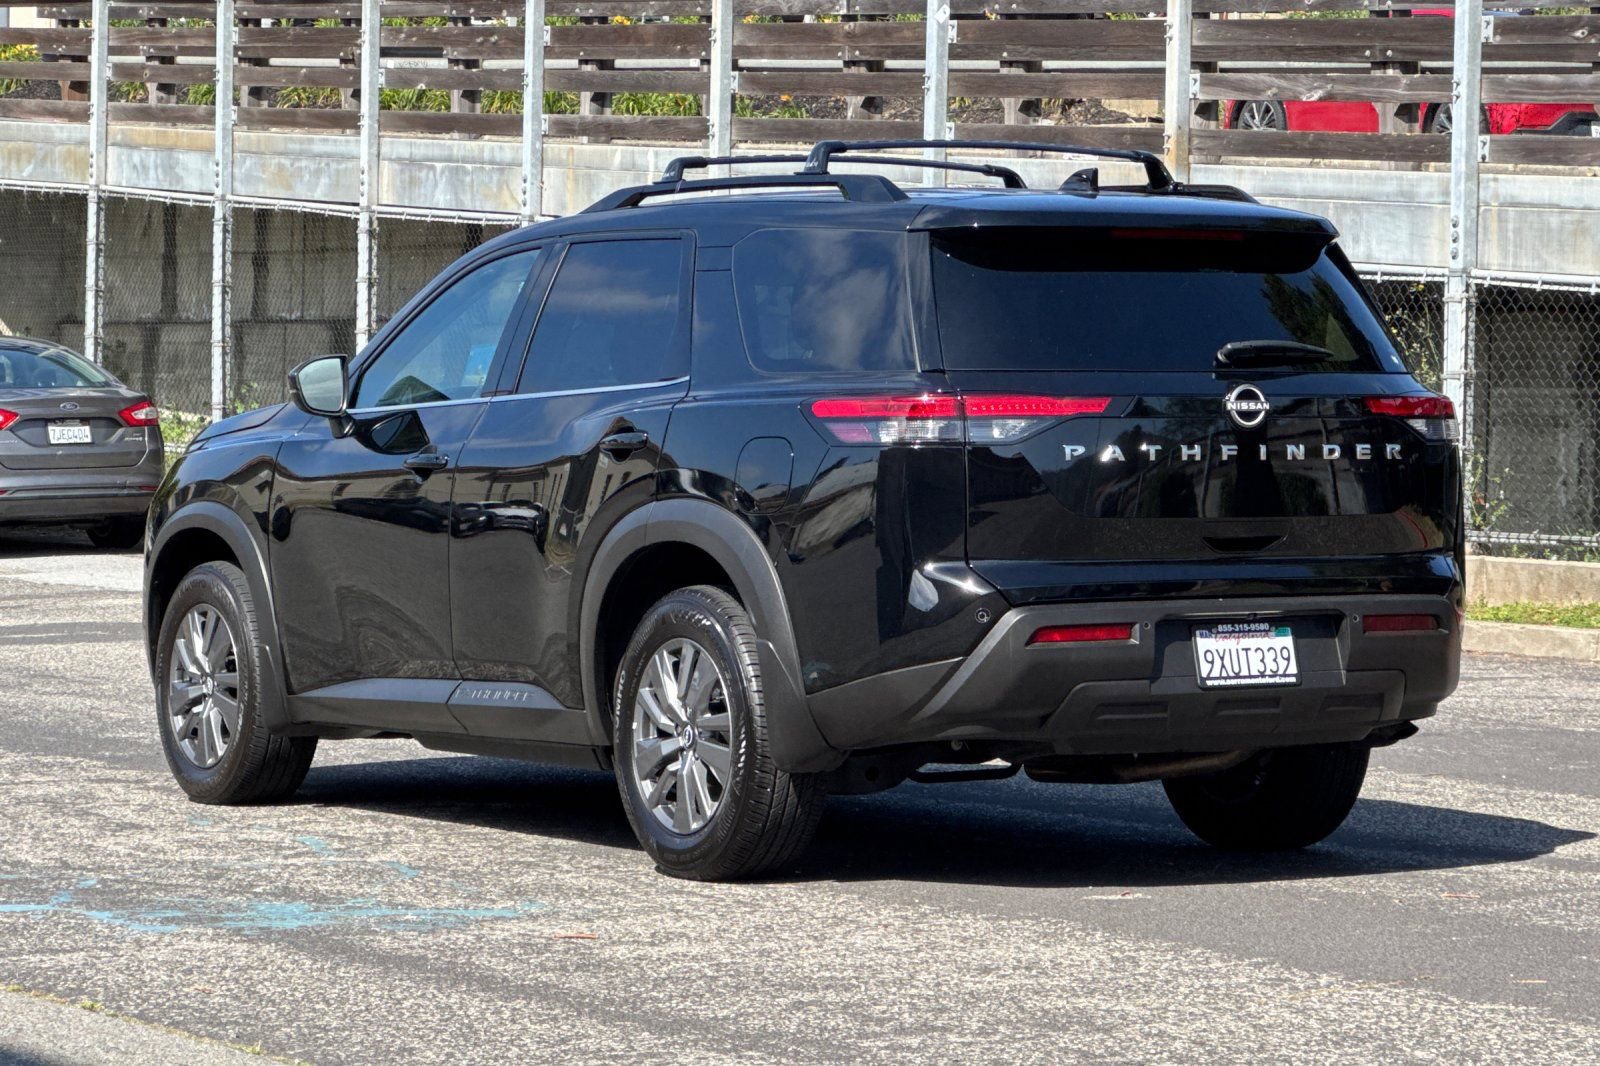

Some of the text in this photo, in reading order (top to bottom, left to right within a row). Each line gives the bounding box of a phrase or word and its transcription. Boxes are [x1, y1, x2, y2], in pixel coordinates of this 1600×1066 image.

[1227, 401, 1270, 410] NISSAN
[1063, 443, 1403, 462] PATHFINDER
[1217, 622, 1270, 632] 855-315-9580
[1204, 646, 1291, 678] 9XUT339
